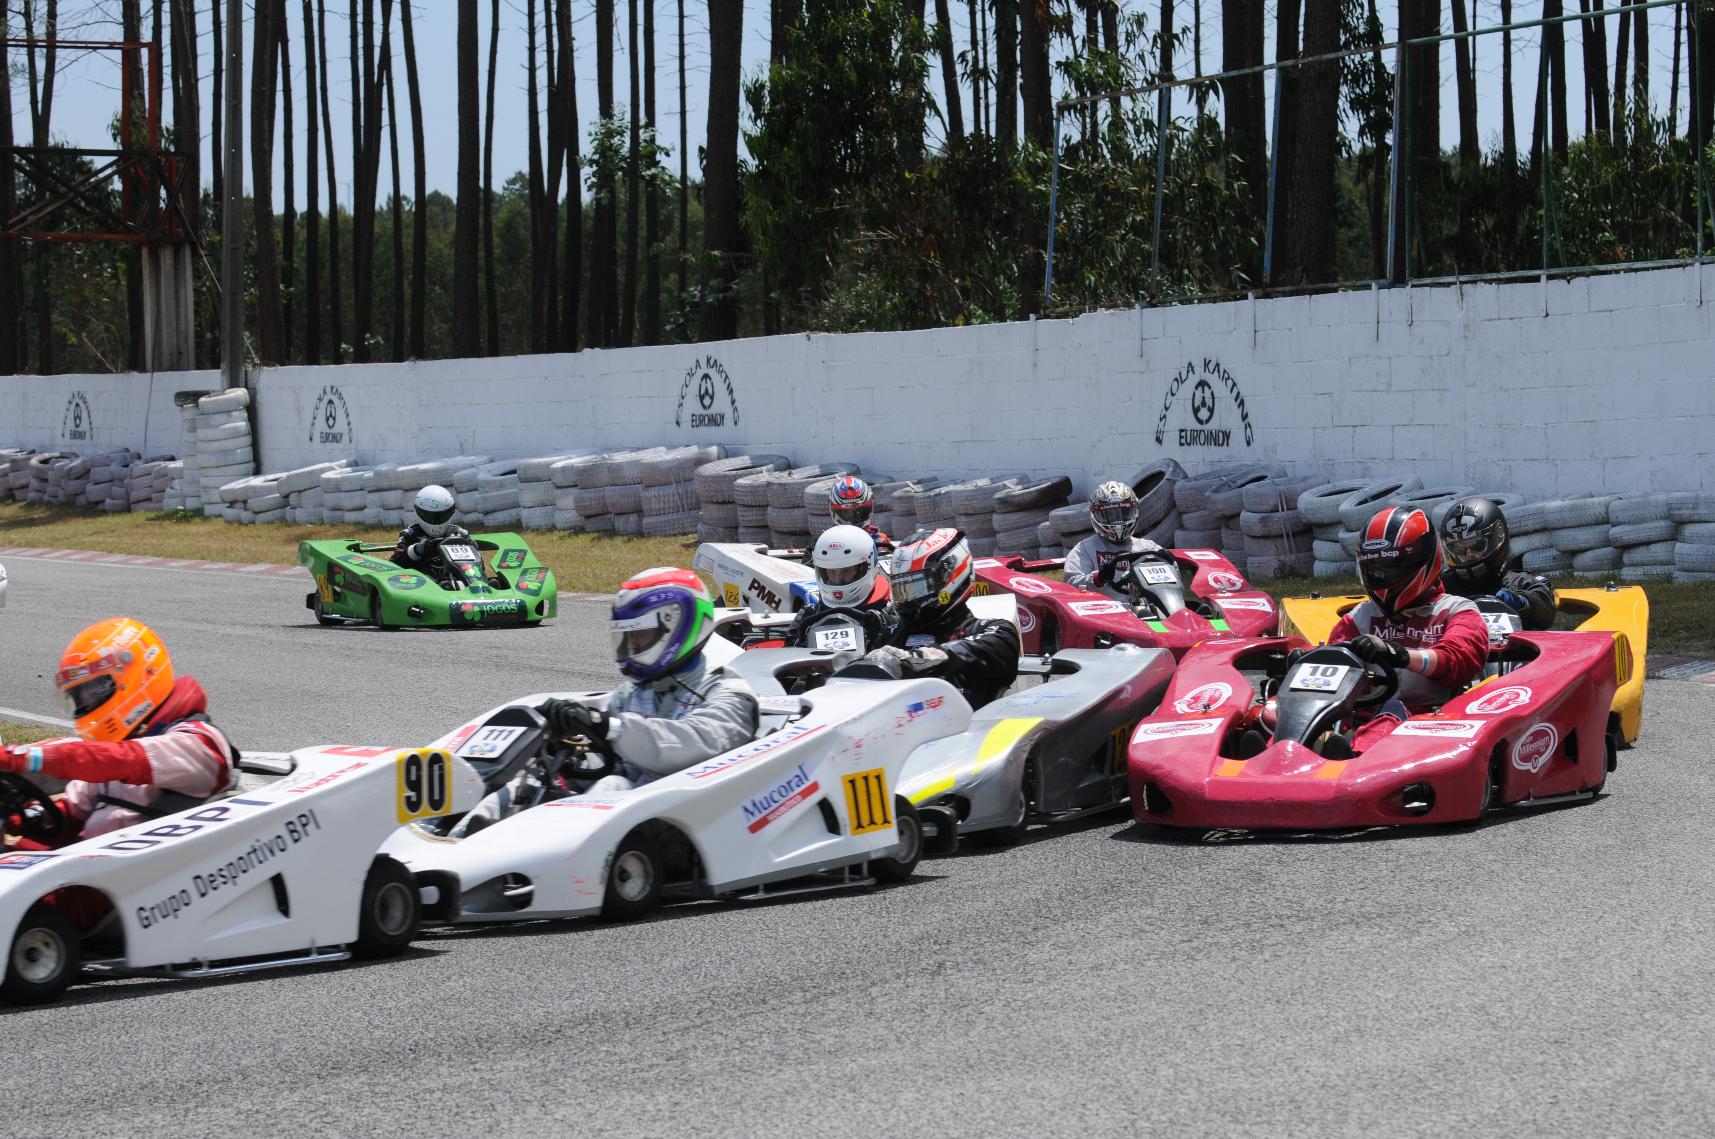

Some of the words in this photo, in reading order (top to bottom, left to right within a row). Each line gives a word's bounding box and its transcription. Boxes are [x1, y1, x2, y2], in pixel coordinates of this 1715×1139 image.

[706, 354, 740, 427] KARTING
[1155, 361, 1196, 446] ESCOLA
[1203, 357, 1255, 447] KARTING
[691, 412, 726, 428] EUROINDY
[1178, 428, 1232, 447] EUROINDY
[1380, 550, 1400, 559] bcp
[725, 589, 740, 605] 126
[748, 577, 783, 611] PMH
[483, 603, 518, 617] JOGOS
[823, 630, 850, 641] 129
[1309, 665, 1340, 678] 10
[483, 728, 517, 741] 111
[403, 751, 447, 814] 90
[742, 763, 810, 822] Mucoral
[848, 773, 892, 830] 111
[136, 889, 192, 929] Grupo
[193, 834, 288, 898] Desportivo
[284, 808, 322, 844] BPI
